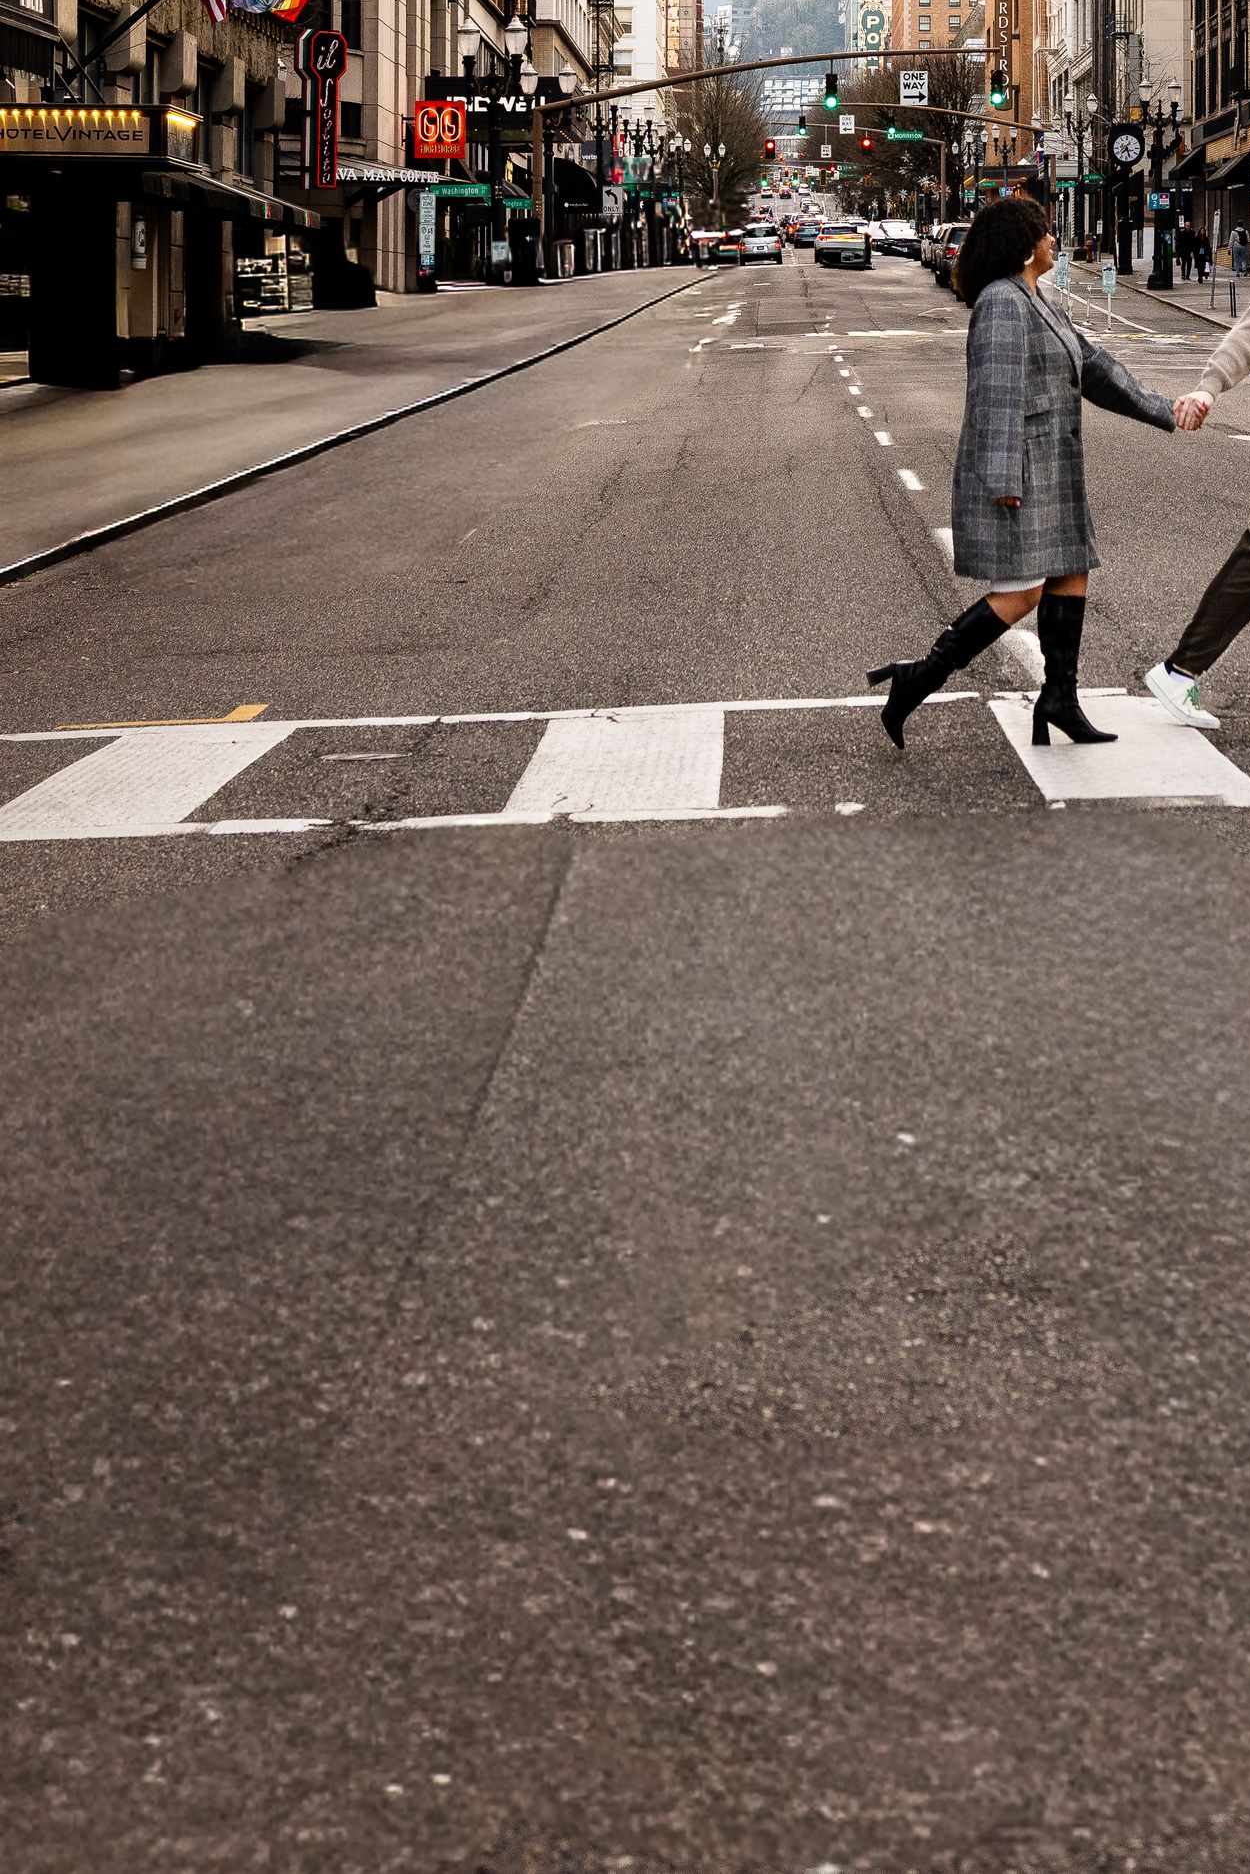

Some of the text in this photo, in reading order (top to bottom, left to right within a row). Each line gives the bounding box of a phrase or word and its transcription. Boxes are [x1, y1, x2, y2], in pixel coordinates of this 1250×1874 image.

[902, 72, 926, 81] ONE
[902, 82, 926, 90] WAY
[336, 167, 440, 184] AVA MAN COFFEE
[442, 184, 479, 197] Washington
[603, 205, 621, 213] ONLY
